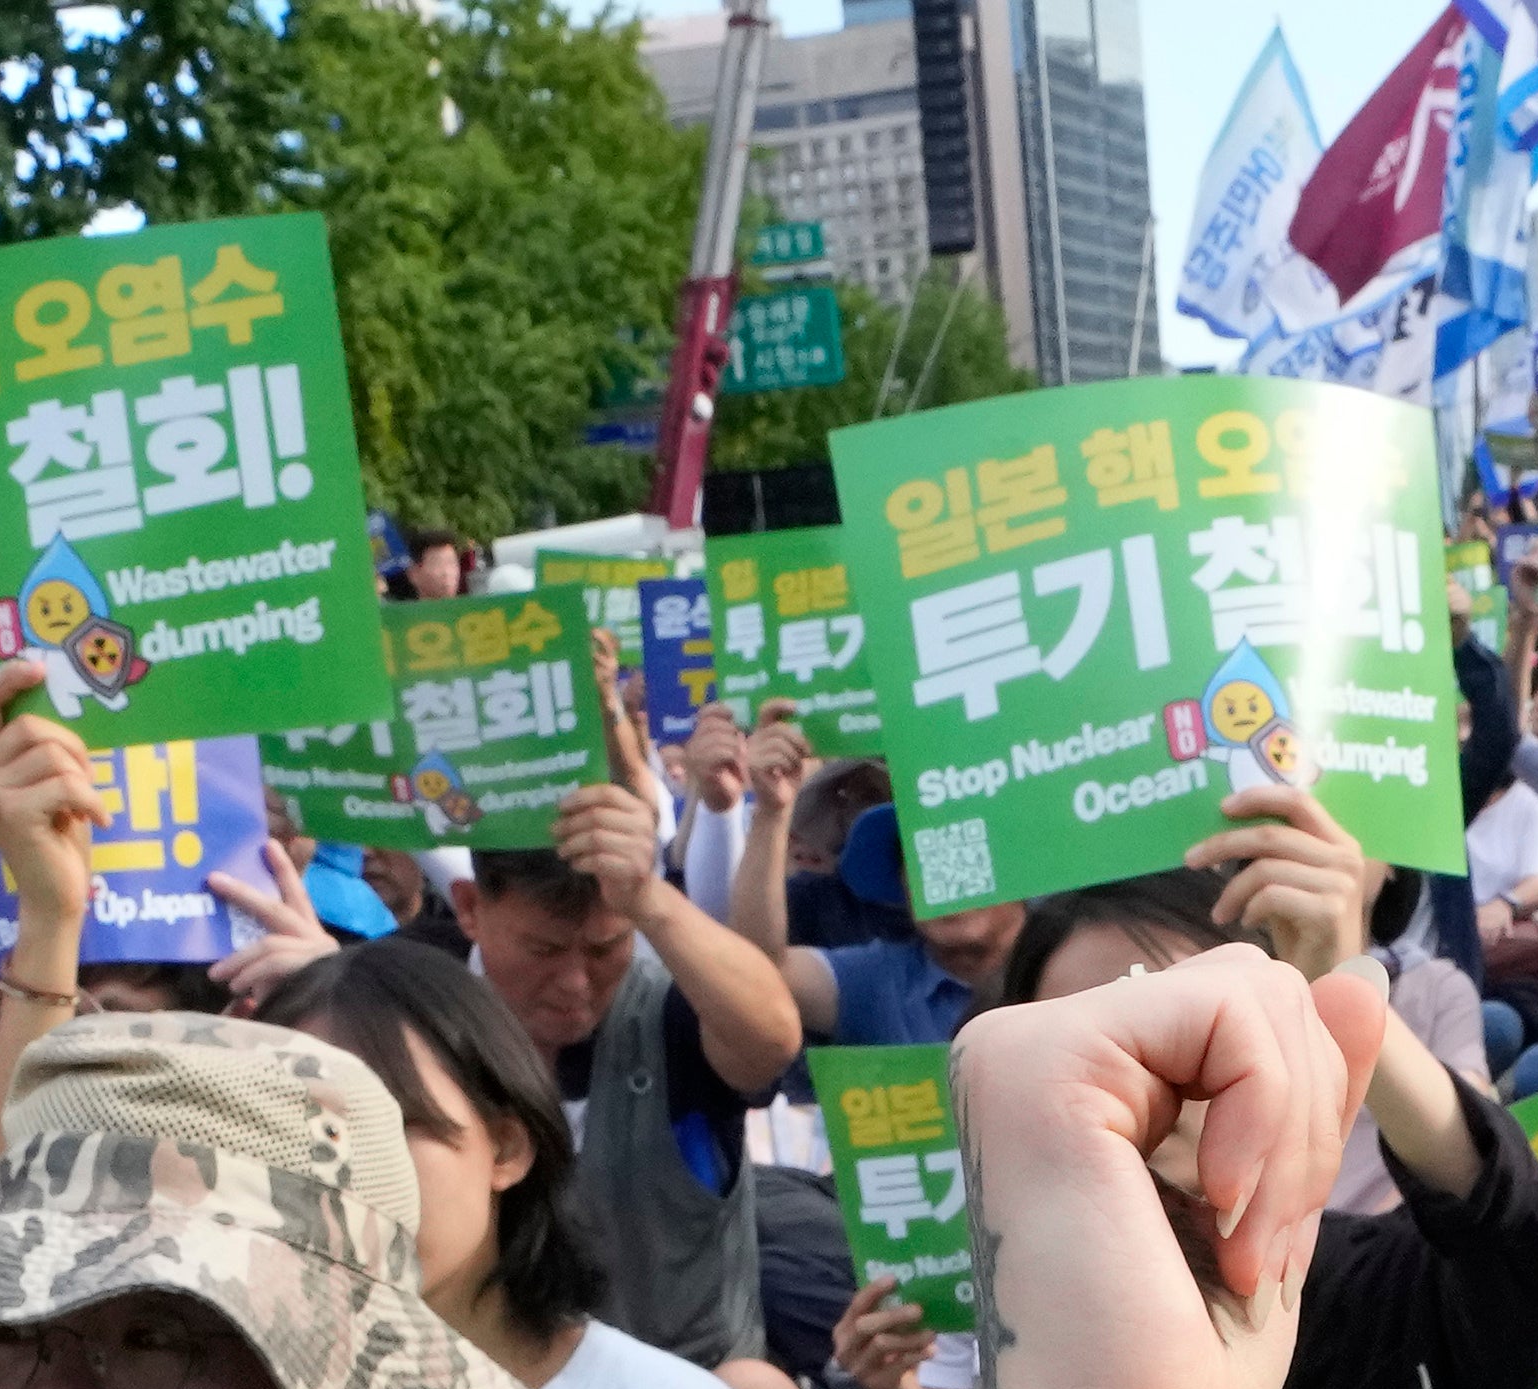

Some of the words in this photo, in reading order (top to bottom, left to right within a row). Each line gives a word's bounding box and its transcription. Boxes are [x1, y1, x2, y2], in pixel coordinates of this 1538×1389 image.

[13, 244, 284, 381] 오염수
[7, 363, 314, 549] 철회!
[885, 444, 1069, 580] 일본
[1081, 419, 1181, 512] 핵
[105, 537, 337, 606] Wastewater
[774, 563, 850, 617] 일본
[141, 597, 325, 664] dumping
[910, 534, 1172, 723] 투기
[401, 658, 579, 752] 철회!
[1173, 703, 1200, 756] NO
[916, 745, 1011, 809] Stop
[1010, 713, 1157, 782] Nuclear
[1073, 759, 1210, 824] Ocean
[1317, 733, 1430, 787] dumping
[139, 887, 217, 926] Japan
[841, 1078, 945, 1147] 일본
